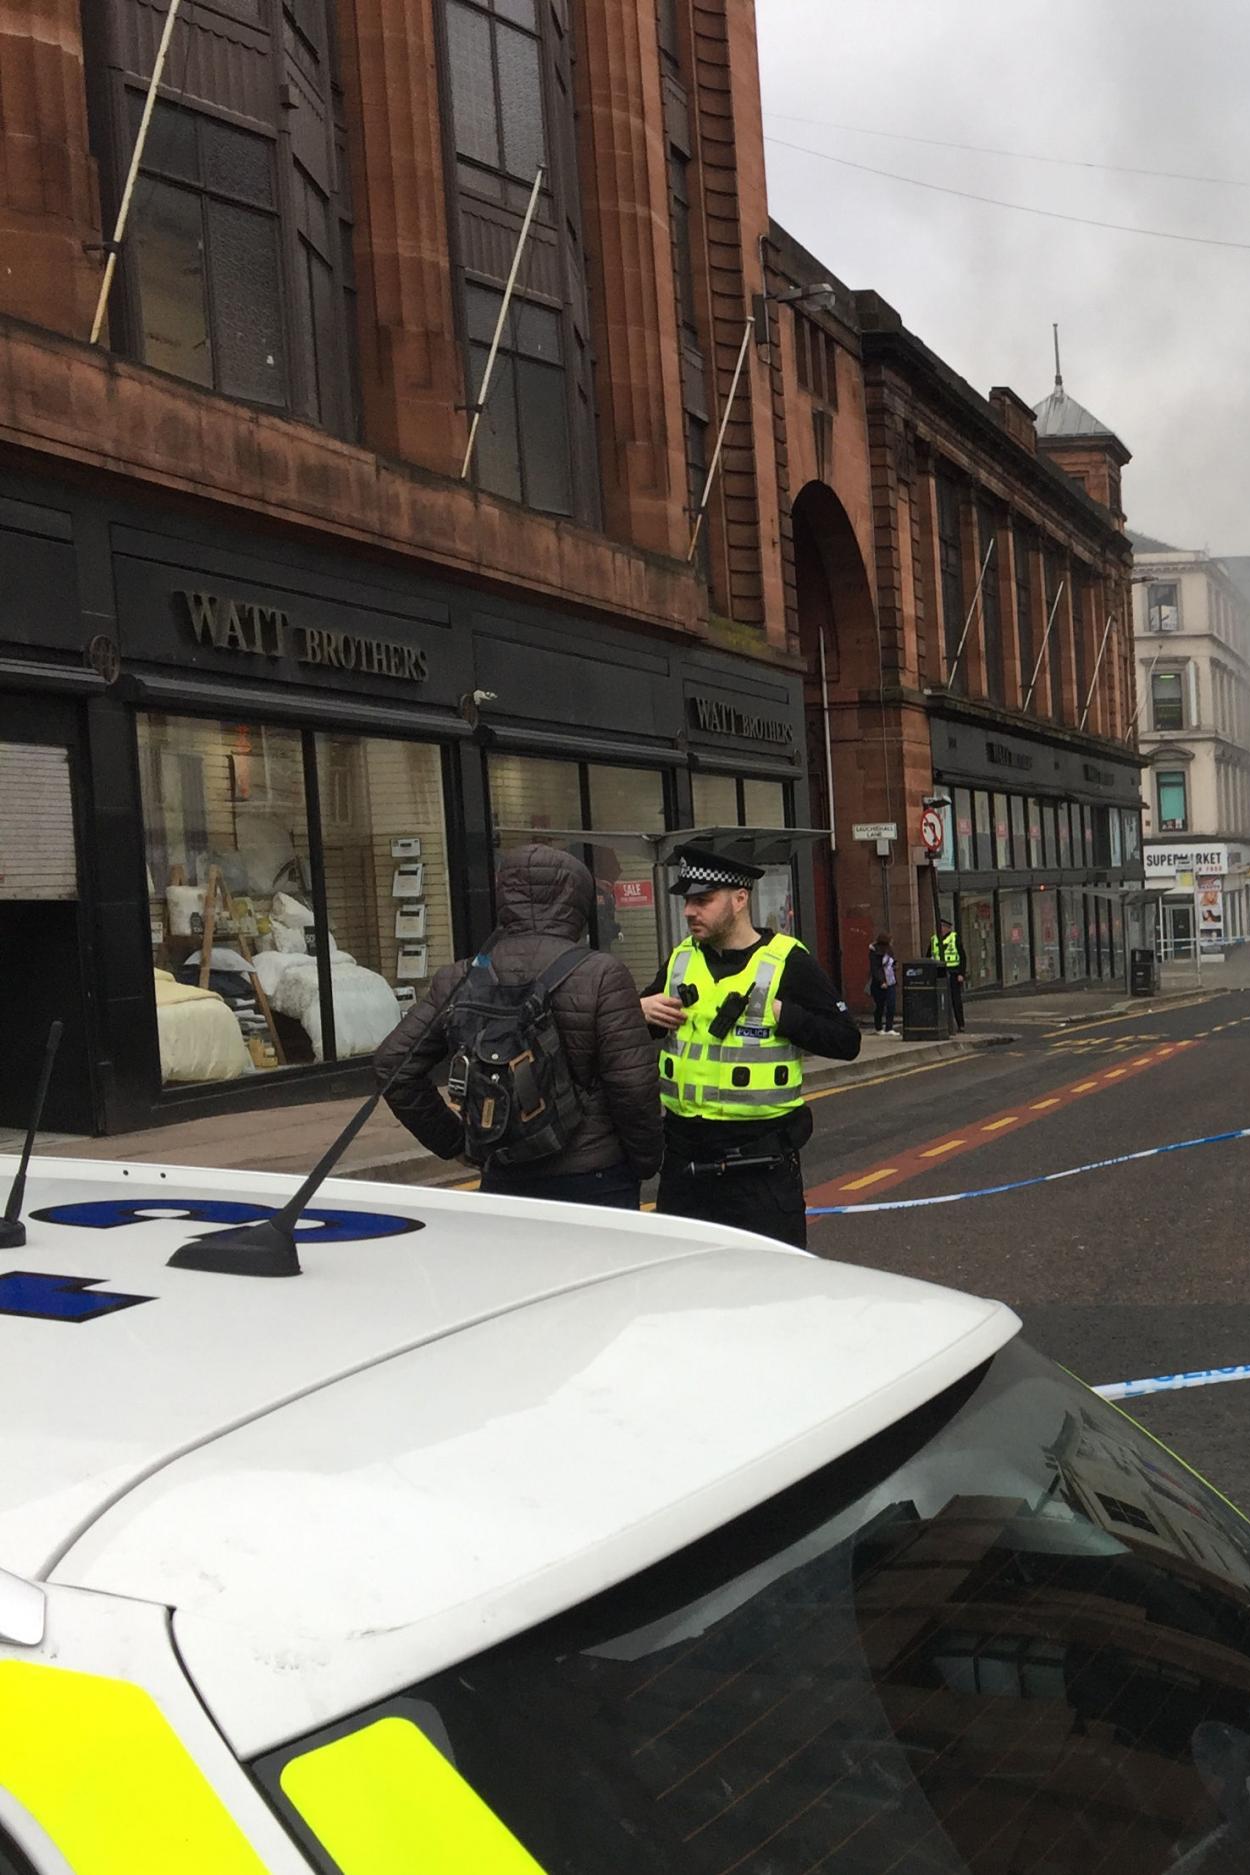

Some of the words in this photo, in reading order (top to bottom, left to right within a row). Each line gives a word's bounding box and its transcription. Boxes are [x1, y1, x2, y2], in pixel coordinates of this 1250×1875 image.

[184, 590, 290, 658] WATT
[298, 626, 430, 682] BROTHERS
[696, 697, 737, 736] WATT
[742, 713, 793, 743] BROTHERS
[737, 1029, 768, 1037] POLICE
